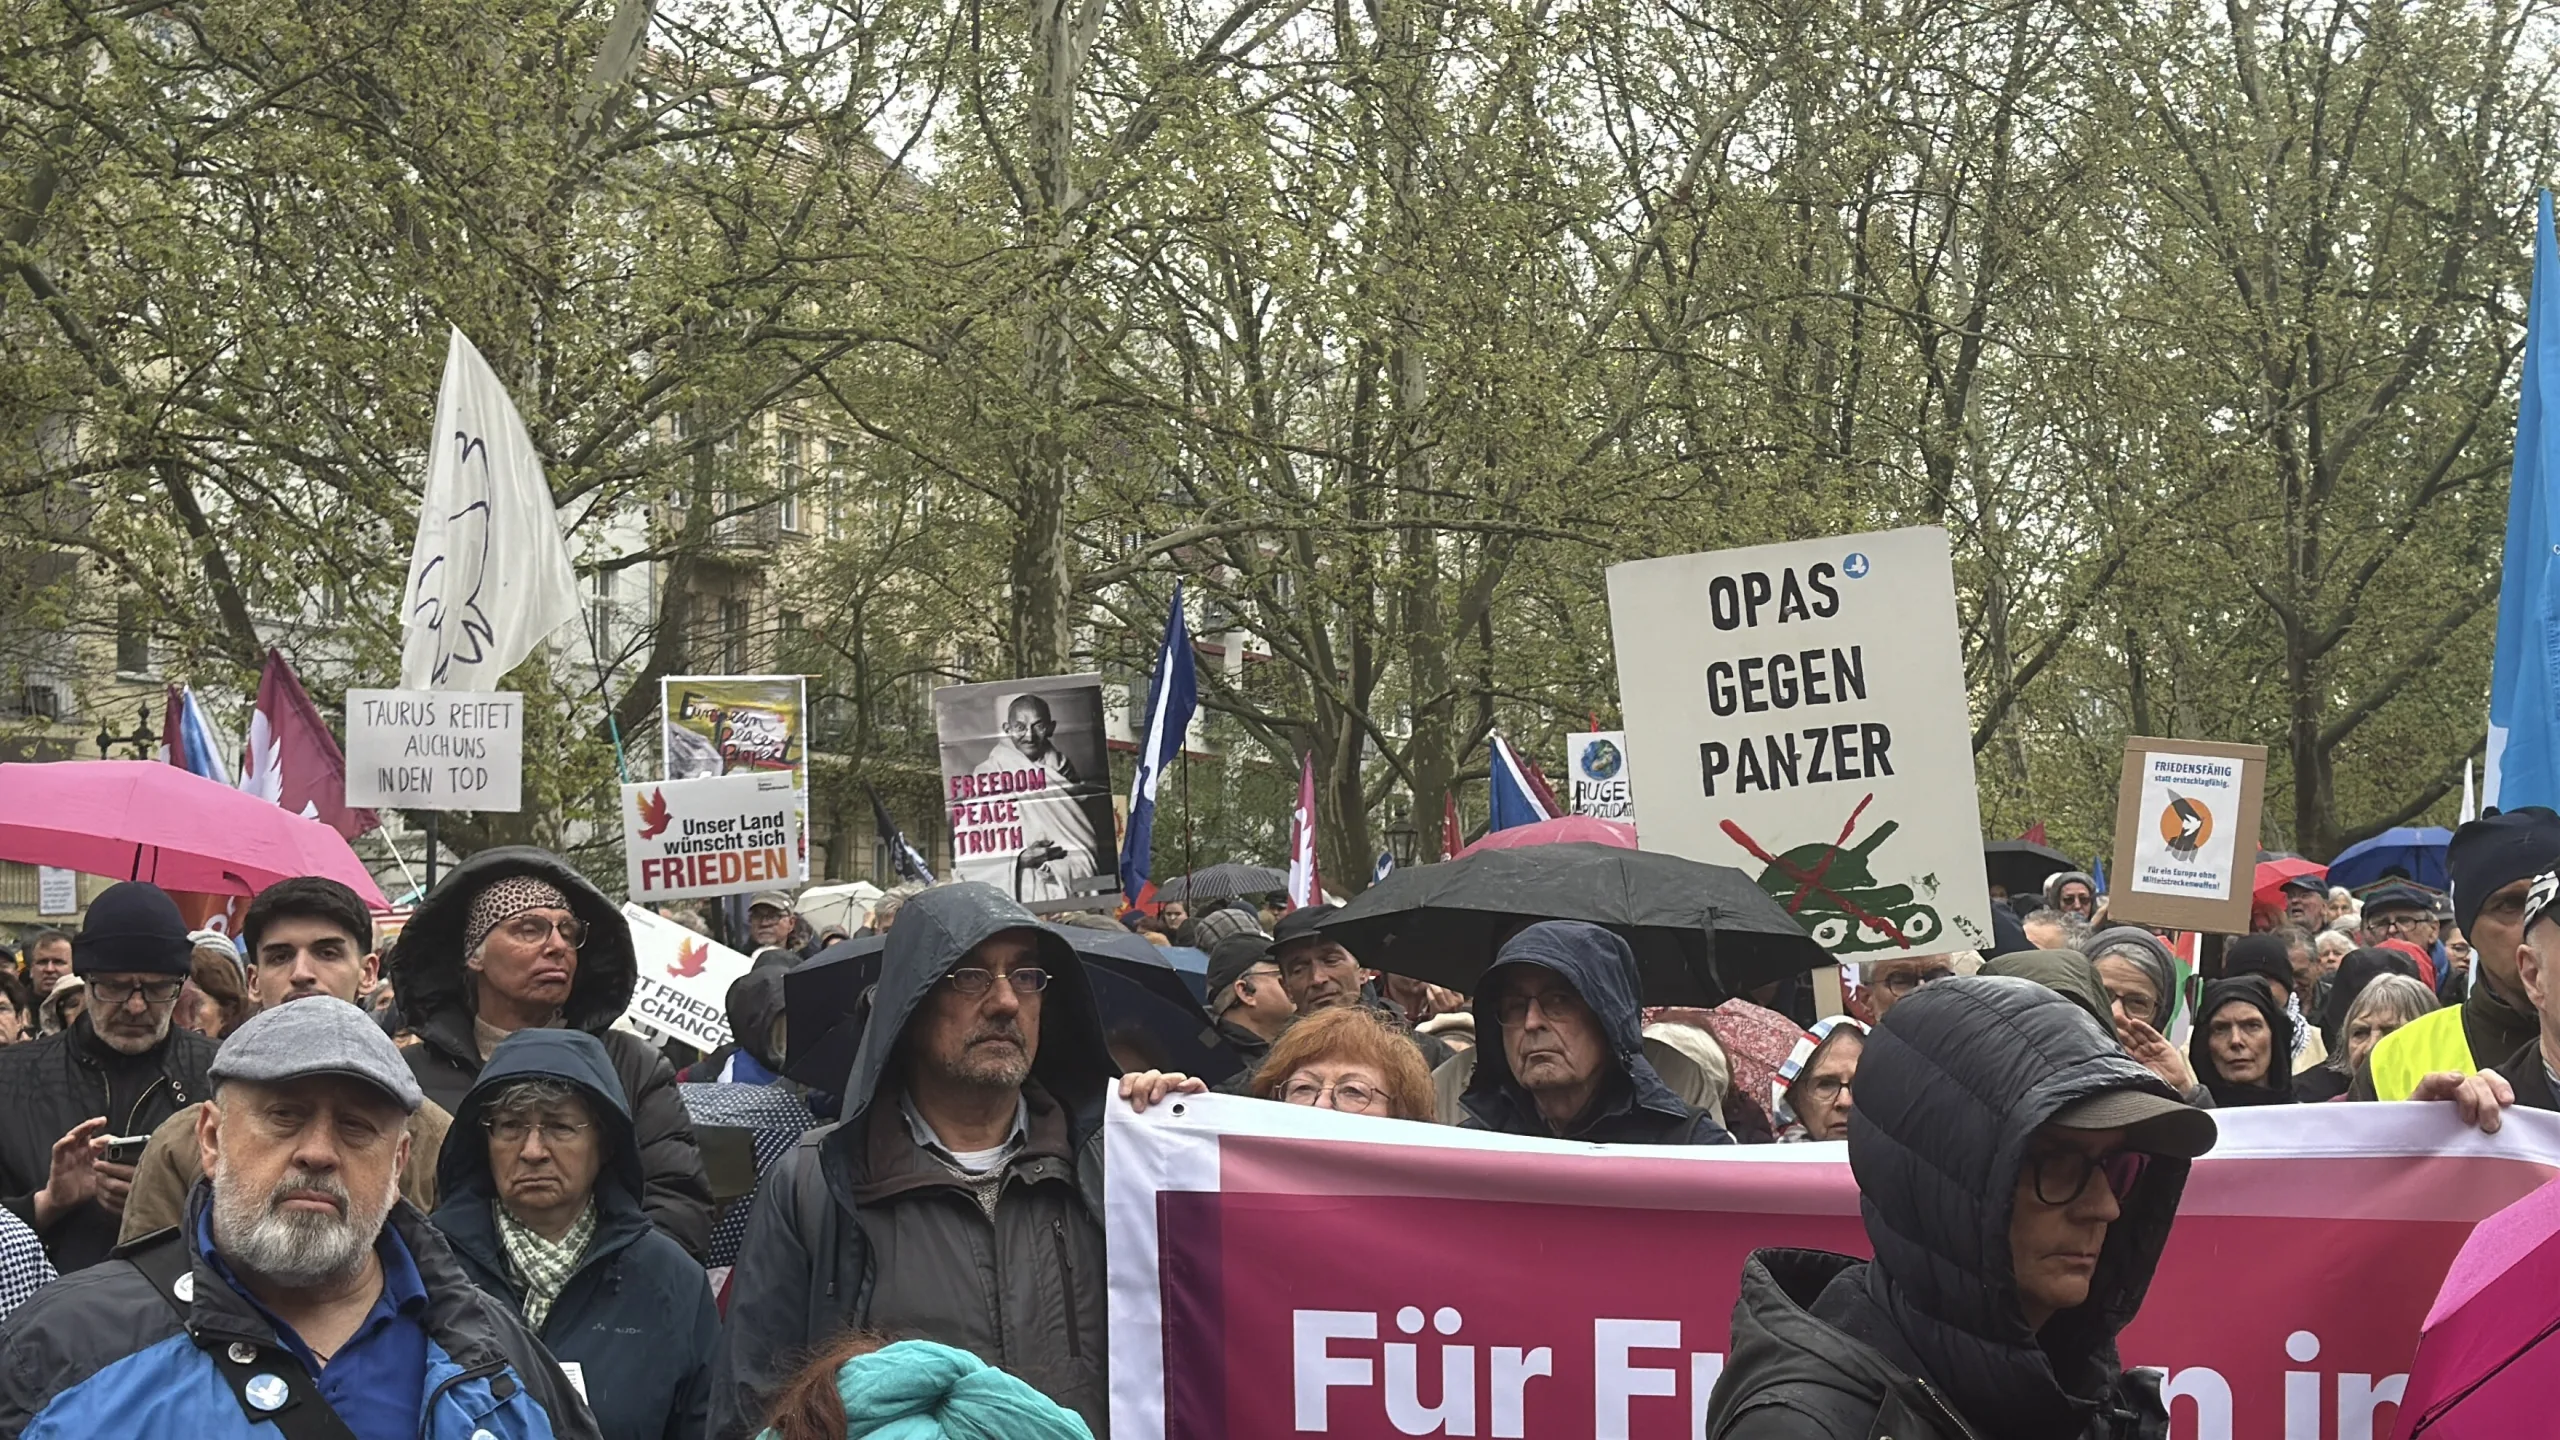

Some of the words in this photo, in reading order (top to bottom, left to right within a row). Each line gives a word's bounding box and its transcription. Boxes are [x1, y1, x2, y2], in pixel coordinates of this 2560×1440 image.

[1709, 562, 1840, 631] OPAS
[1706, 645, 1867, 717] GEGEN
[363, 700, 435, 727] TAURUS
[449, 703, 514, 729] REITET
[1699, 722, 1895, 797] PANZER
[2154, 762, 2232, 777] FRIEDENSFÄHIG
[448, 767, 488, 793] TOD
[949, 767, 1047, 800] FREEDOM
[683, 818, 736, 836] Unser
[740, 811, 784, 831] Land
[951, 798, 1020, 828] PEACE
[664, 834, 743, 855] wünscht
[747, 829, 786, 848] sich
[955, 826, 1024, 856] TRUTH
[641, 847, 789, 891] FRIEDEN
[2173, 868, 2197, 879] Europa
[1293, 1306, 1552, 1439] Für
